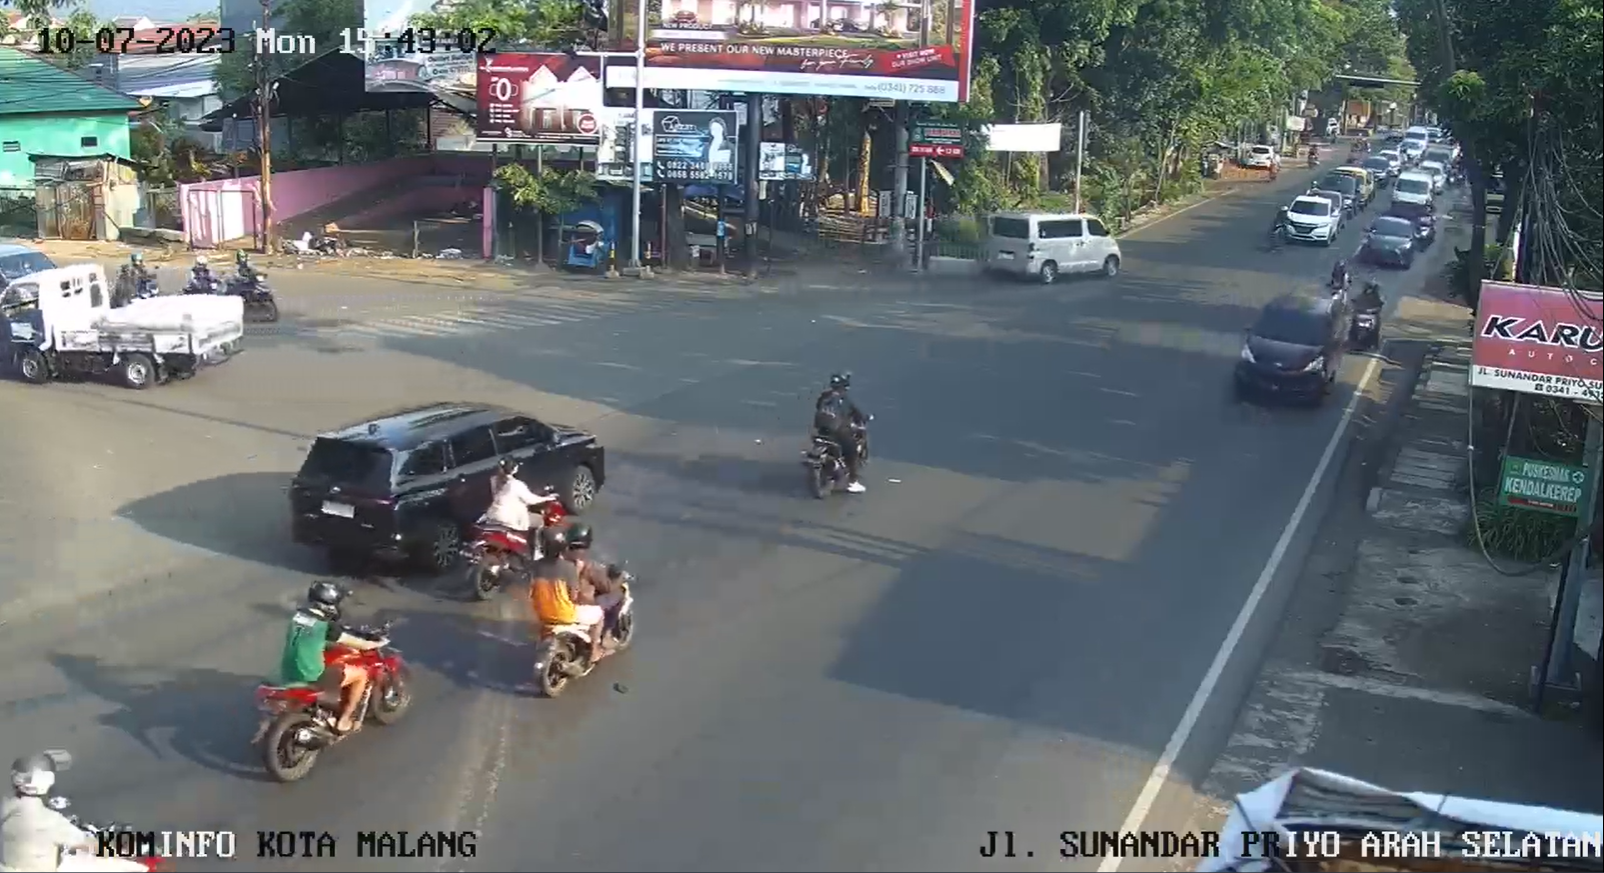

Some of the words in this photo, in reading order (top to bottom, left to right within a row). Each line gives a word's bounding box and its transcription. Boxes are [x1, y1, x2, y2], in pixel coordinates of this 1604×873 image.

[661, 42, 675, 52] WE
[678, 43, 723, 54] PRESENT
[726, 45, 749, 55] OUR
[752, 46, 774, 55] NEW
[776, 47, 847, 59] MASTERPIECE
[878, 82, 907, 93] (0341)
[909, 84, 926, 93] 725
[1508, 348, 1574, 364] AUTO
[1494, 368, 1553, 385] SUNANDAR
[1555, 375, 1586, 388] PRIYO
[1546, 384, 1570, 395] 0341
[1522, 462, 1571, 482] PUSKESMAS
[1504, 476, 1582, 502] KENDALKEREP
